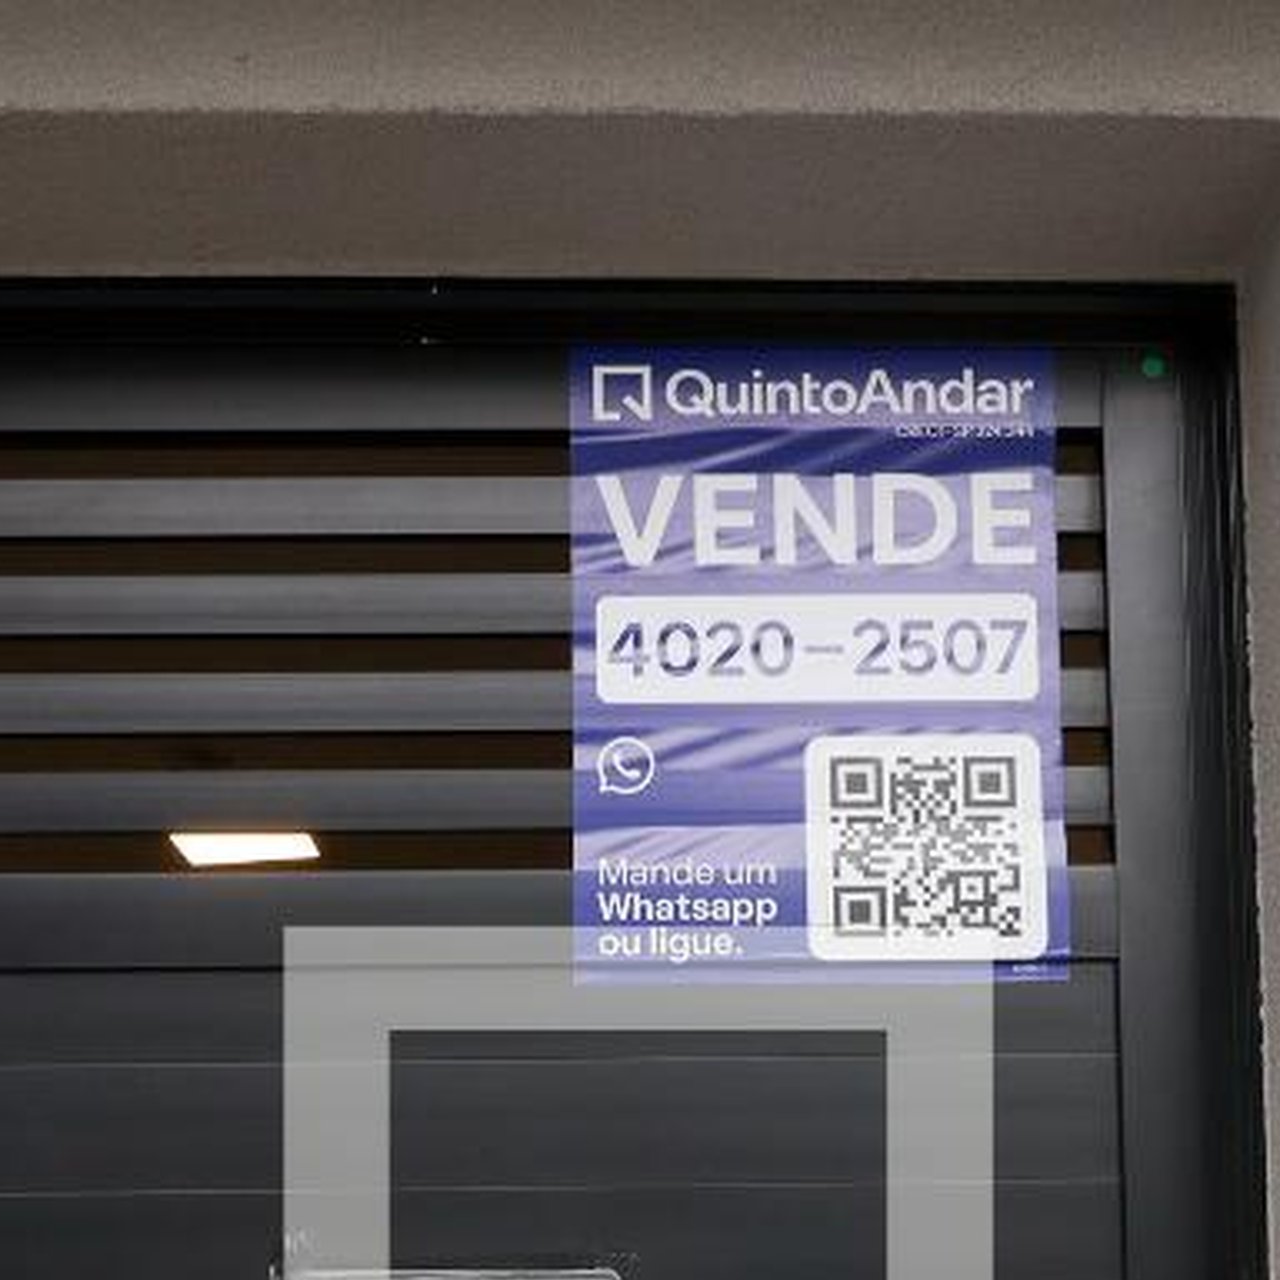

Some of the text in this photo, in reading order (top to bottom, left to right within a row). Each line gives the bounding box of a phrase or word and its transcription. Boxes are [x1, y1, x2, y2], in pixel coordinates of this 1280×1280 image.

[664, 368, 1035, 419] QuintoAndar
[595, 472, 1038, 567] VENDE
[598, 857, 778, 885] Mande um
[596, 892, 778, 926] Whatsapp
[598, 926, 744, 964] ou ligue.
